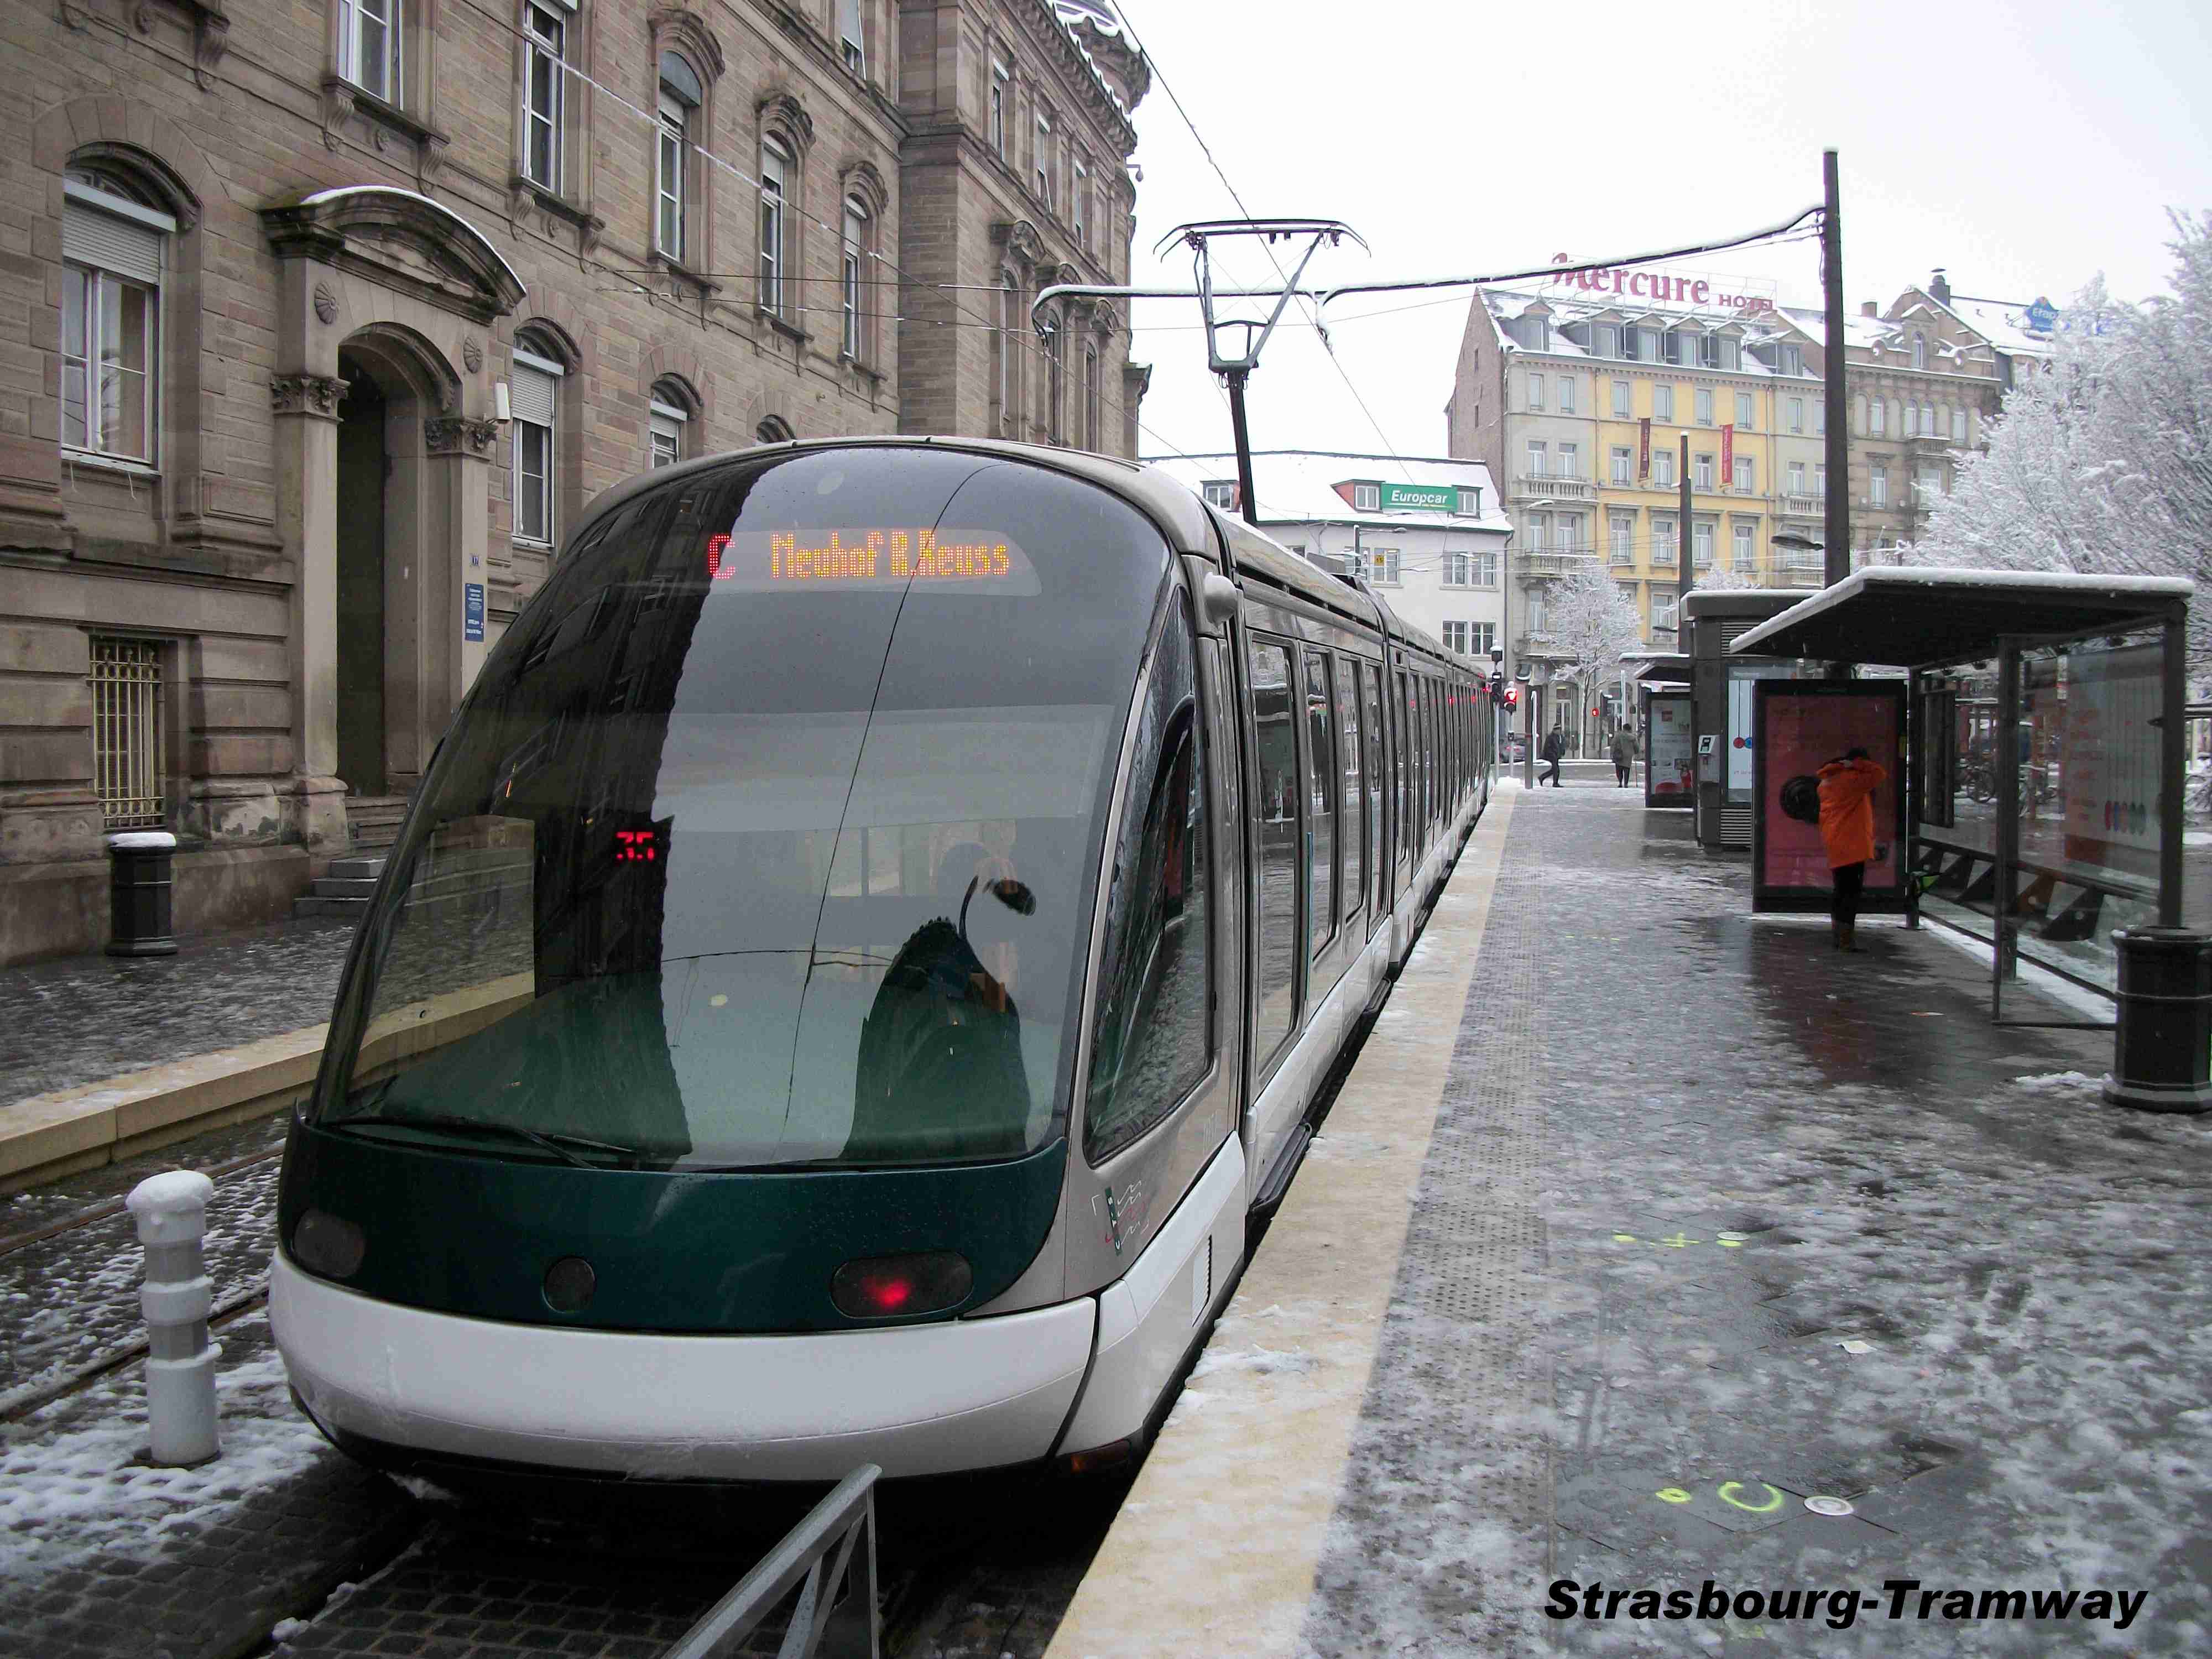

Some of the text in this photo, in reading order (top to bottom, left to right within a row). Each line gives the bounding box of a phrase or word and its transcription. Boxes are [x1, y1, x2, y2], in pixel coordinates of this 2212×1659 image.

[1391, 489, 1448, 507] Europcar
[708, 534, 736, 580] C
[770, 531, 884, 578] Neuhof
